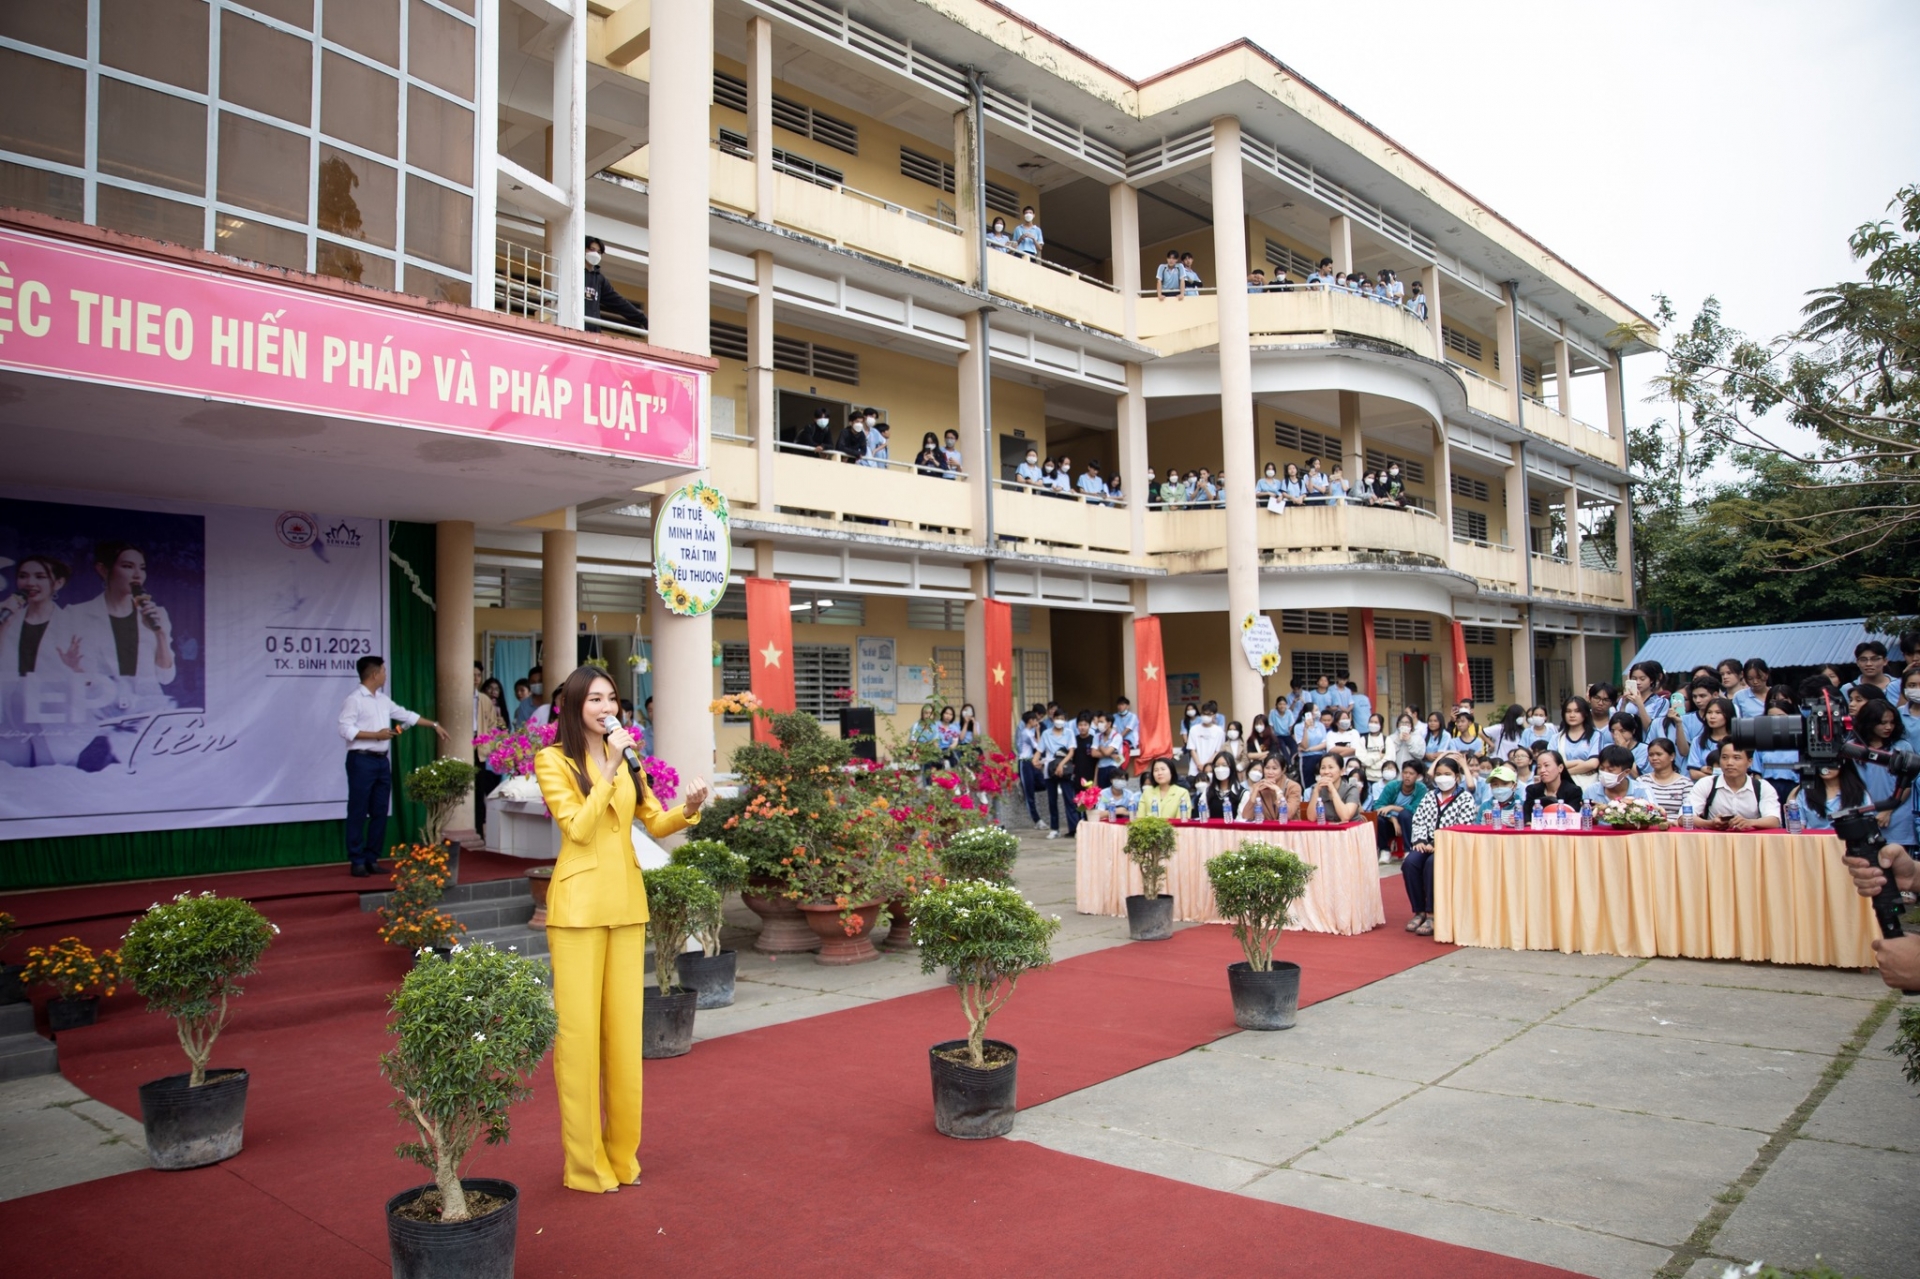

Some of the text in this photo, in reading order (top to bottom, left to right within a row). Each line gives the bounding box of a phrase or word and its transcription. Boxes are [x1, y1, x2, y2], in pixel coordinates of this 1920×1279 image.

[70, 289, 194, 361] THEO
[211, 309, 307, 379] HIẾN
[323, 335, 421, 395] PHÁP
[433, 349, 478, 406] VÀ
[489, 365, 573, 420] PHÁP
[672, 505, 702, 525] TRÍ TUỆ
[668, 524, 715, 542] MINH MẪN
[680, 545, 716, 562] TRÁI TIM
[672, 566, 724, 584] YÊU THƯƠNG
[274, 656, 357, 670] TX. BÌNH MIN
